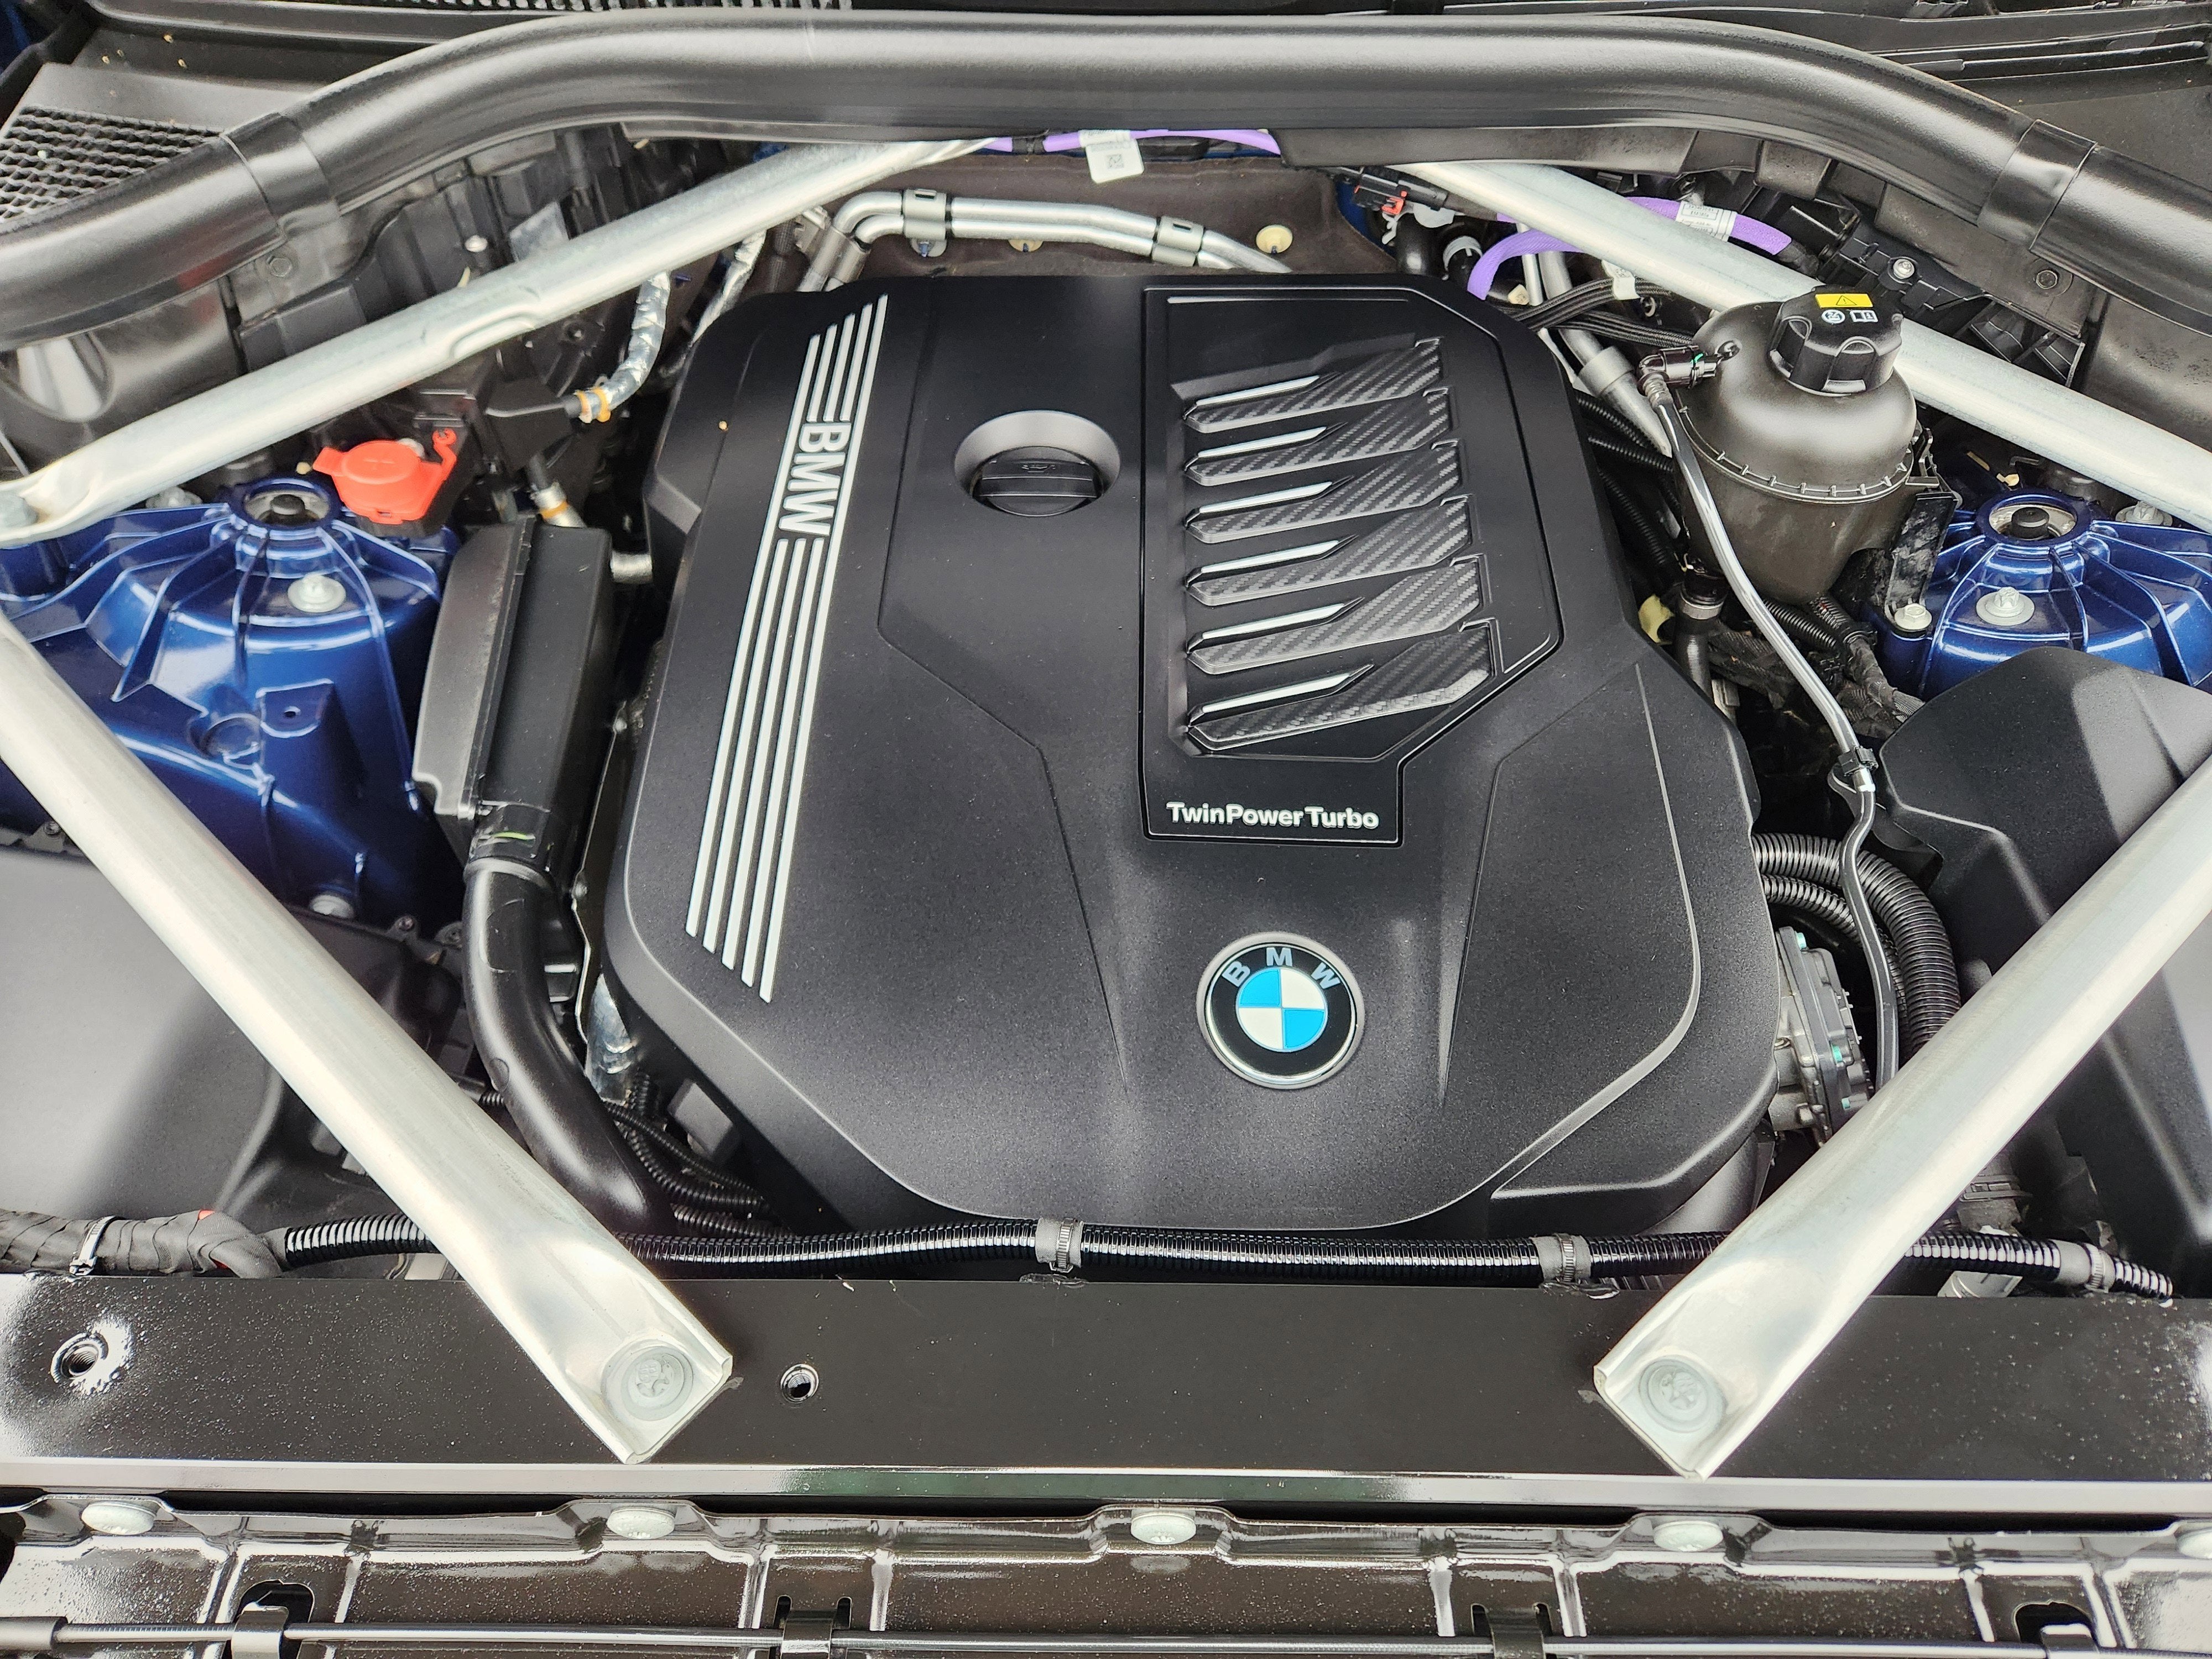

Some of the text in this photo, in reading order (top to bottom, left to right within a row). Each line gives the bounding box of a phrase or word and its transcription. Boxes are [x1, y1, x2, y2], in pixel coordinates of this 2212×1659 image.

[778, 422, 852, 536] BMW
[1166, 801, 1380, 830] TwinPower Turbo
[1221, 947, 1341, 990] BMW
